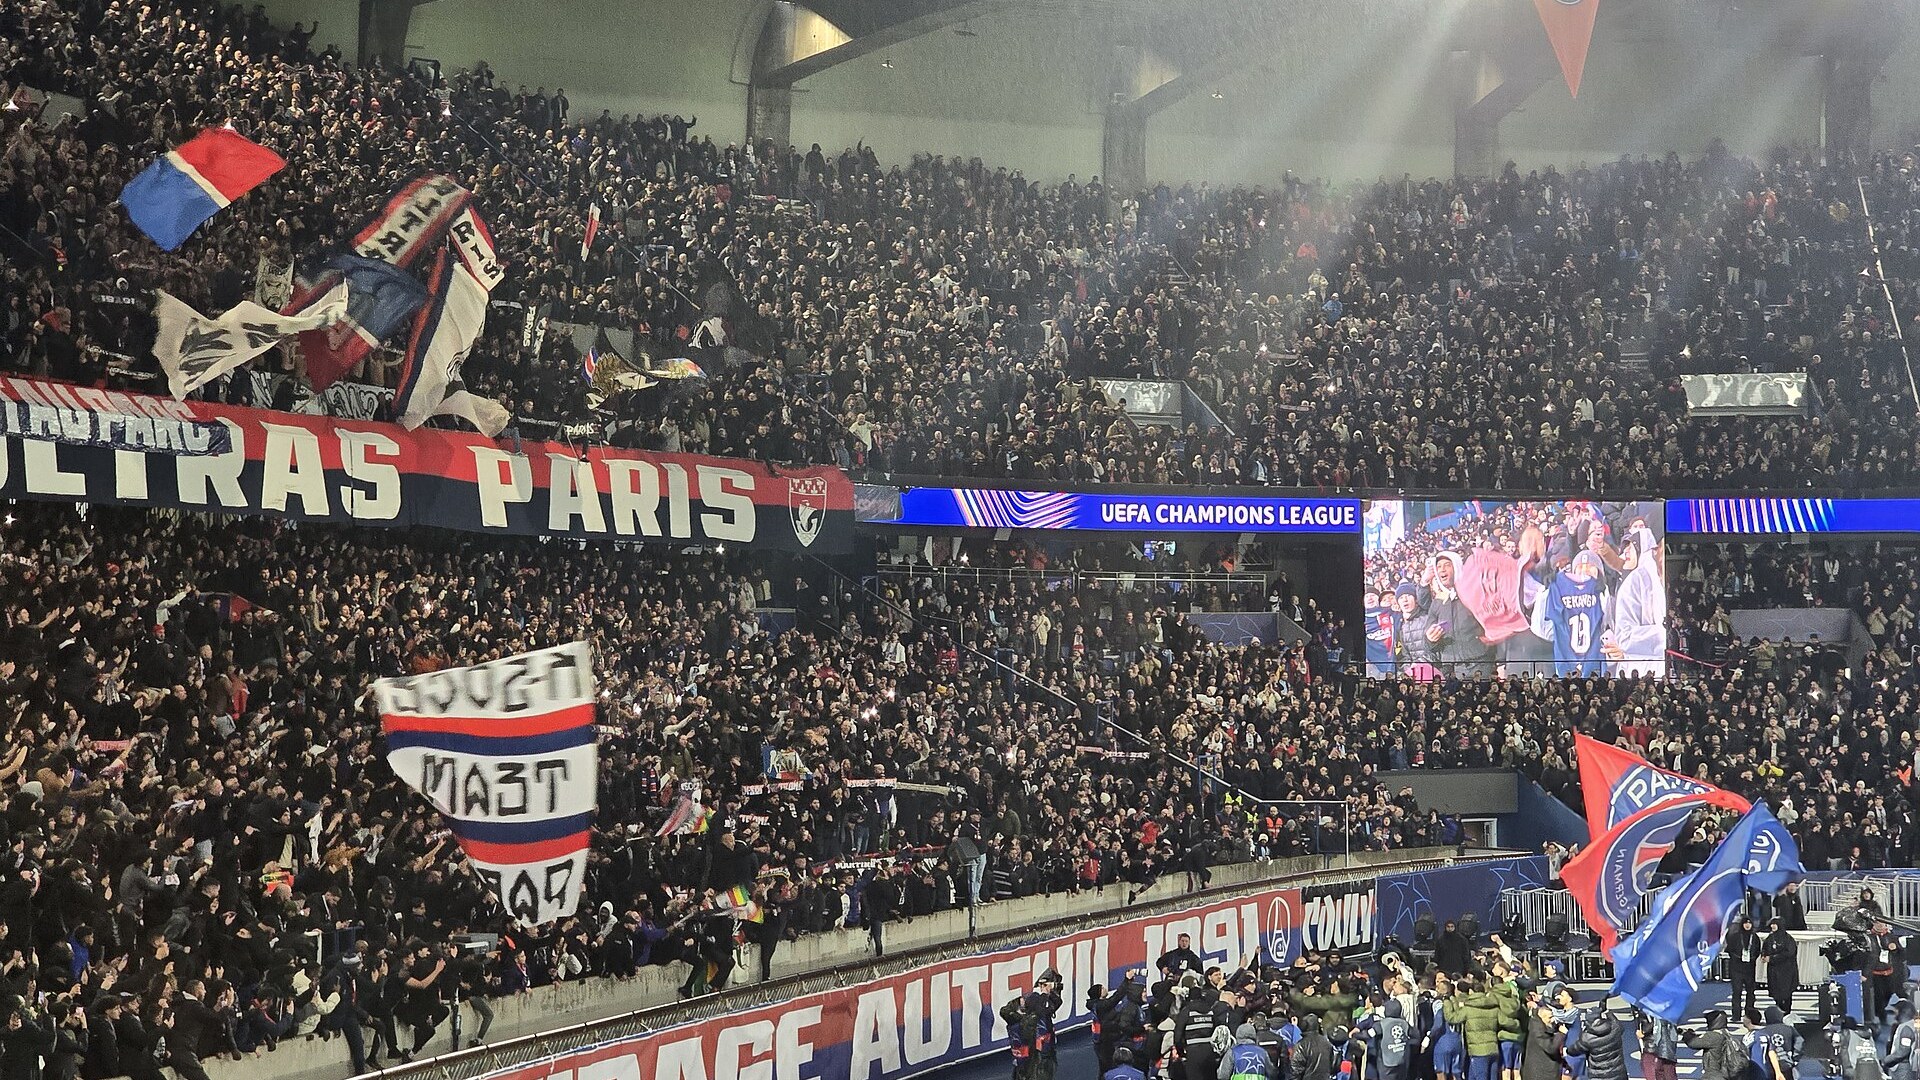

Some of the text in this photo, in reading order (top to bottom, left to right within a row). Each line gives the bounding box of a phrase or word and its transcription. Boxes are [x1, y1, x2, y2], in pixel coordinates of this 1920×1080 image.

[0, 417, 757, 542] LRAS PARIS
[1101, 503, 1356, 526] UEFA CHAMPIONS LEAGUE
[849, 935, 1119, 1080] AUTEUIL
[1142, 902, 1261, 997] 1991
